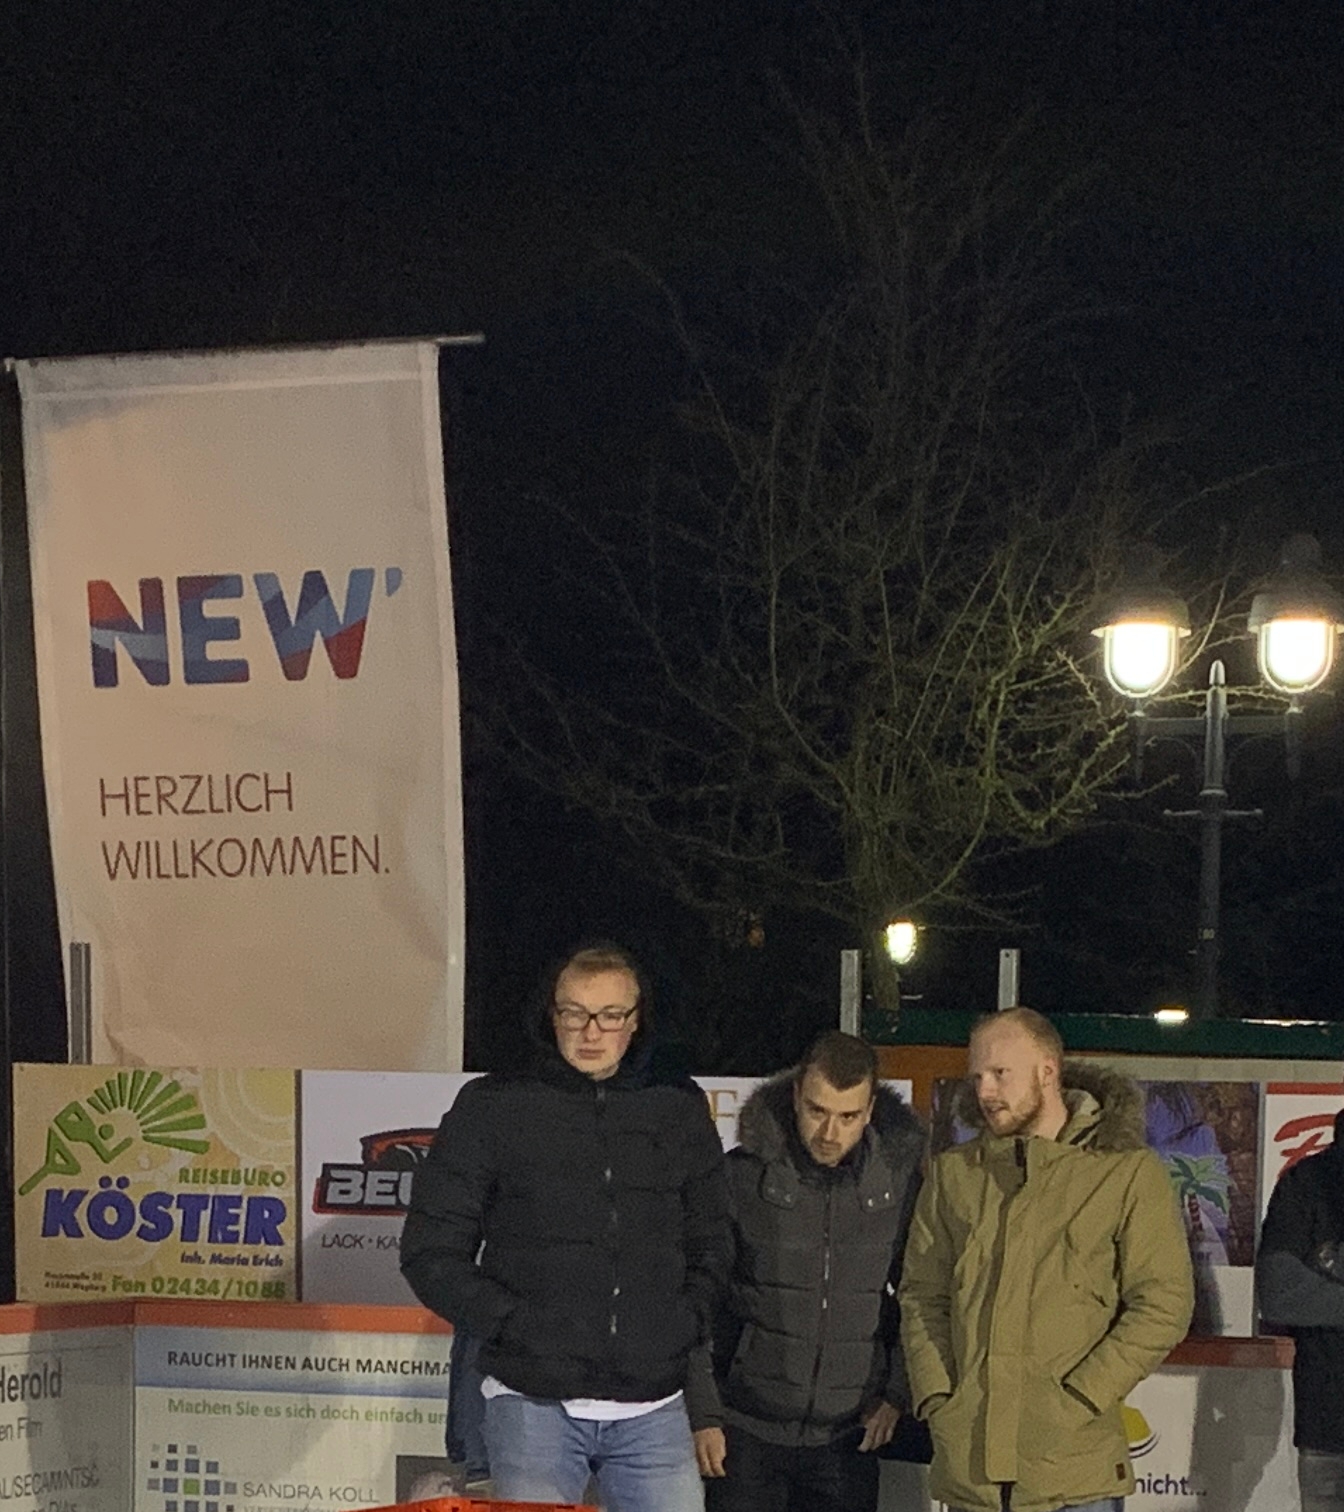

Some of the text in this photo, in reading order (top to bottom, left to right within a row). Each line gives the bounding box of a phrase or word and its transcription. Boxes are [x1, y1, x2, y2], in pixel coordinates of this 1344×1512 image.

[99, 771, 294, 817] HERZLICH
[102, 833, 390, 881] WILLKOMMEN.
[41, 1175, 287, 1246] KÖSTER
[321, 1233, 365, 1249] LACK
[209, 1253, 249, 1266] Maria
[167, 1350, 236, 1369] RAUCHT
[242, 1353, 296, 1371] IHNEN
[301, 1356, 350, 1373] AUCH
[167, 1398, 232, 1418] Machen
[236, 1400, 260, 1417] Sie
[264, 1406, 282, 1418] es
[285, 1402, 316, 1420] sich
[320, 1403, 359, 1422] doch
[364, 1405, 424, 1424] einfach
[17, 1416, 43, 1440] Film
[242, 1482, 380, 1503] SANDRA KOLL
